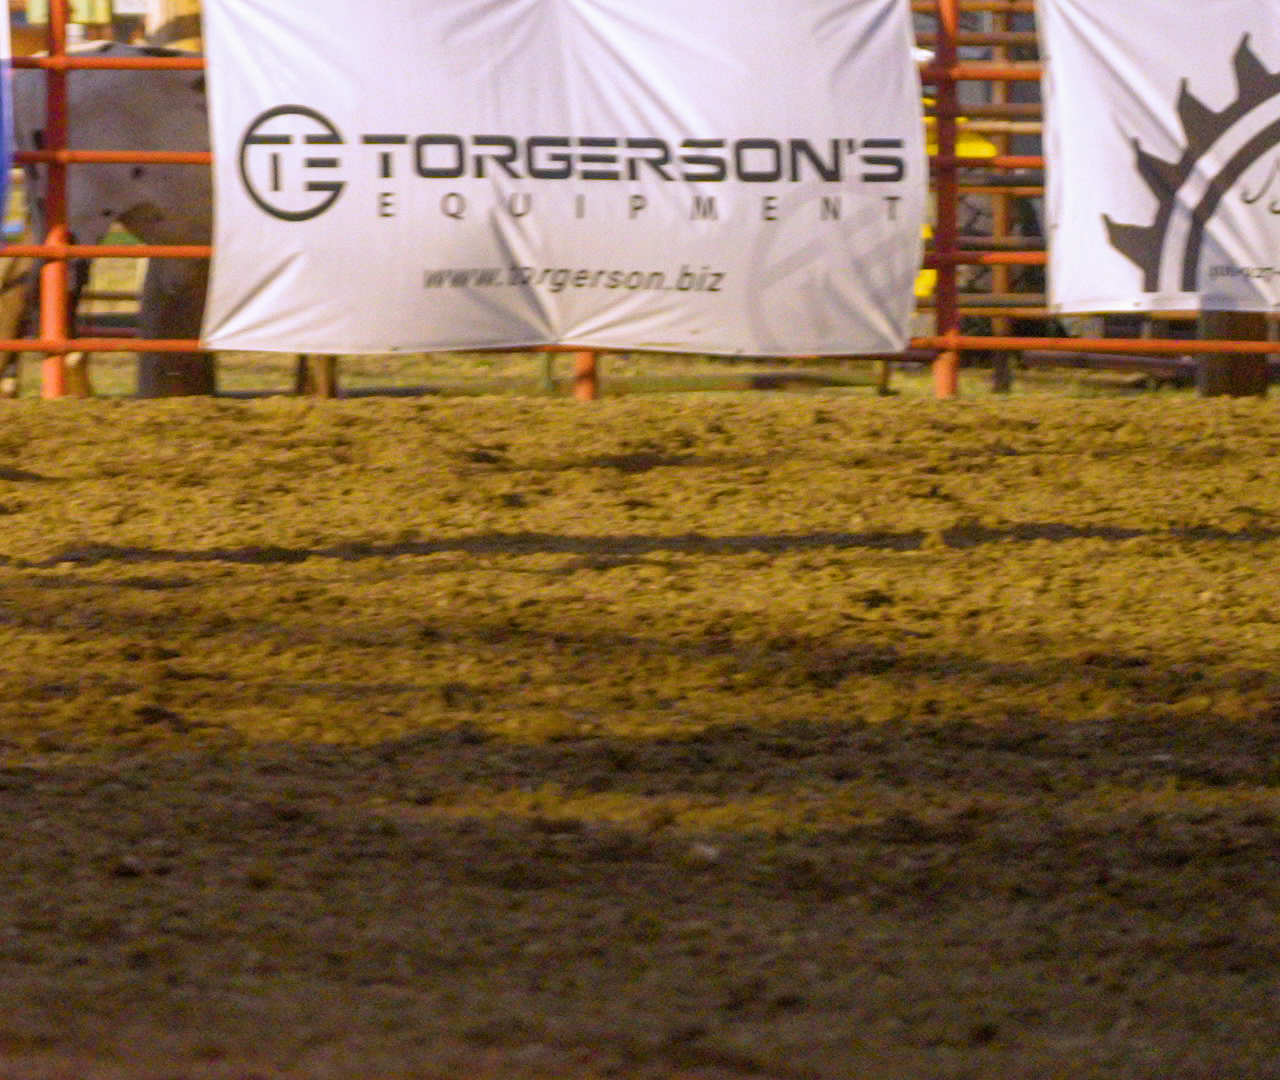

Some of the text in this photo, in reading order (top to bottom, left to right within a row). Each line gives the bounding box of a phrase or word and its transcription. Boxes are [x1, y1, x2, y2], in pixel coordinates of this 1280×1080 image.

[360, 133, 906, 184] TORGERSON'S
[378, 192, 901, 221] EQUIPMENT
[423, 264, 726, 293] www.torgerson.biz
